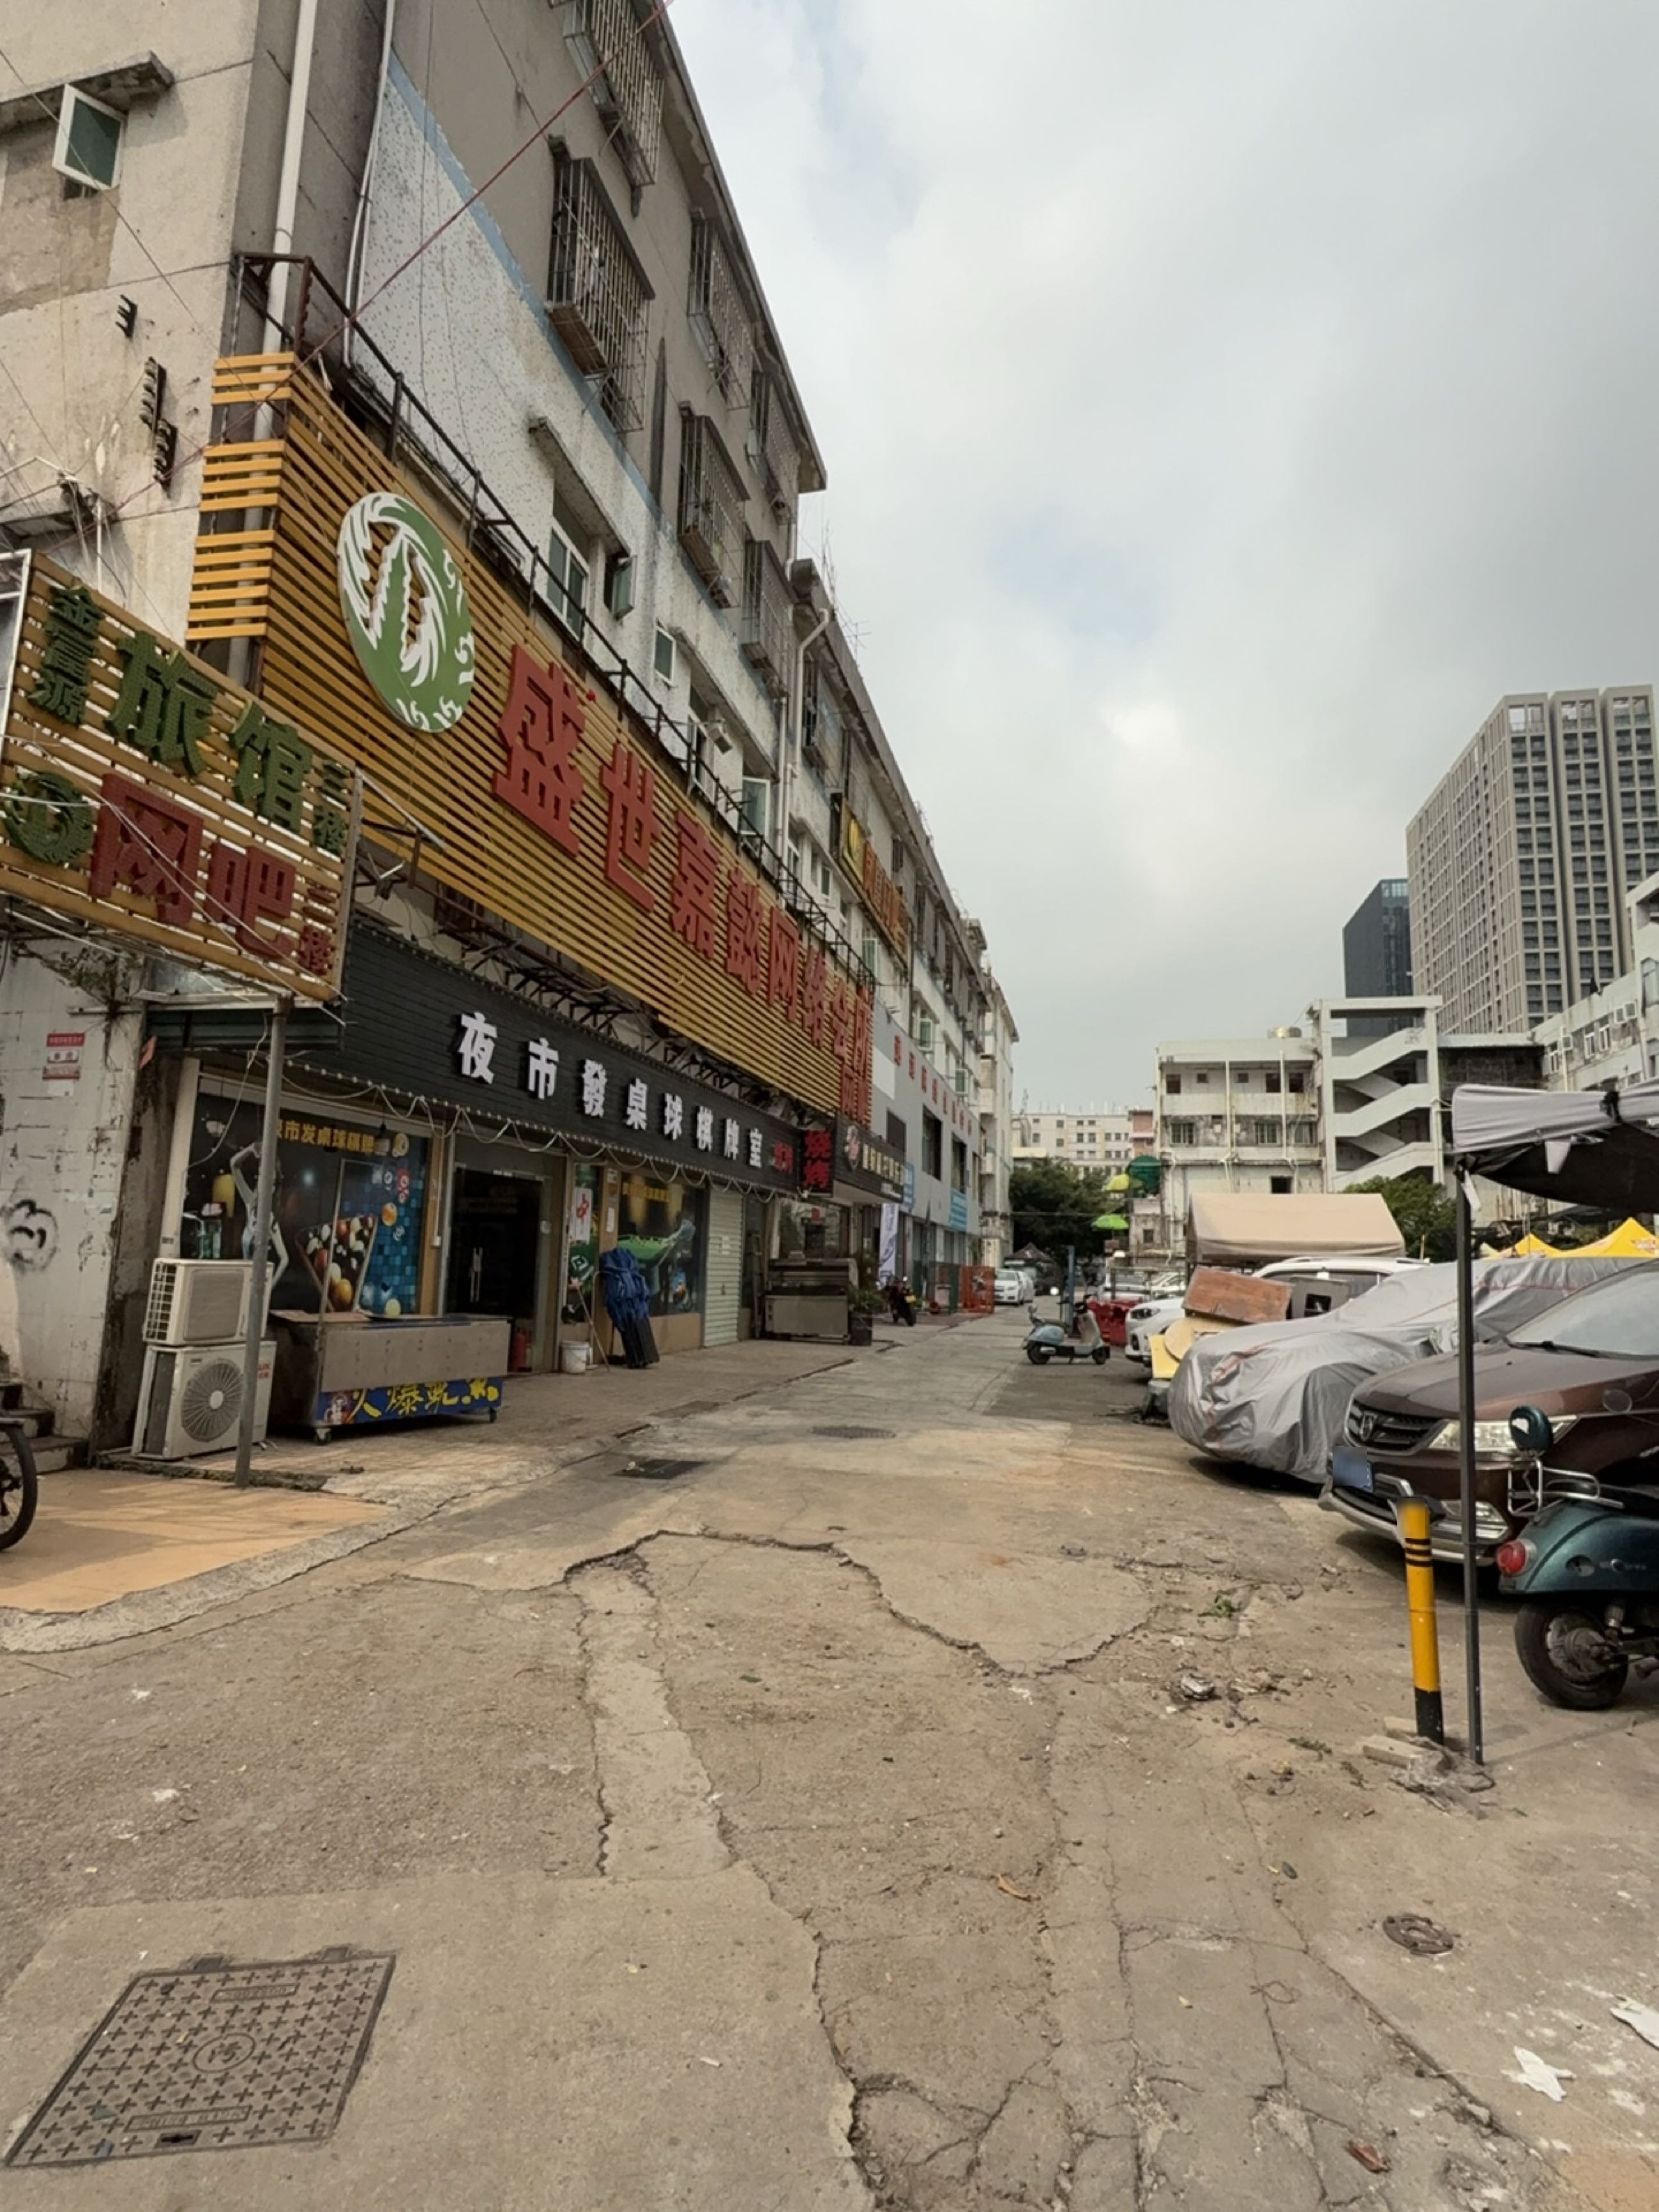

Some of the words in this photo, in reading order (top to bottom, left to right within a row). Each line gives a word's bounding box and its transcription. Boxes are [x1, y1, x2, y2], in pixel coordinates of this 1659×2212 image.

[104, 630, 312, 835] 旅馆
[88, 773, 296, 960] 网吧
[493, 643, 872, 1077] 盛世嘉懿网络会所
[457, 1012, 762, 1167] 夜市發桌球棋牌室
